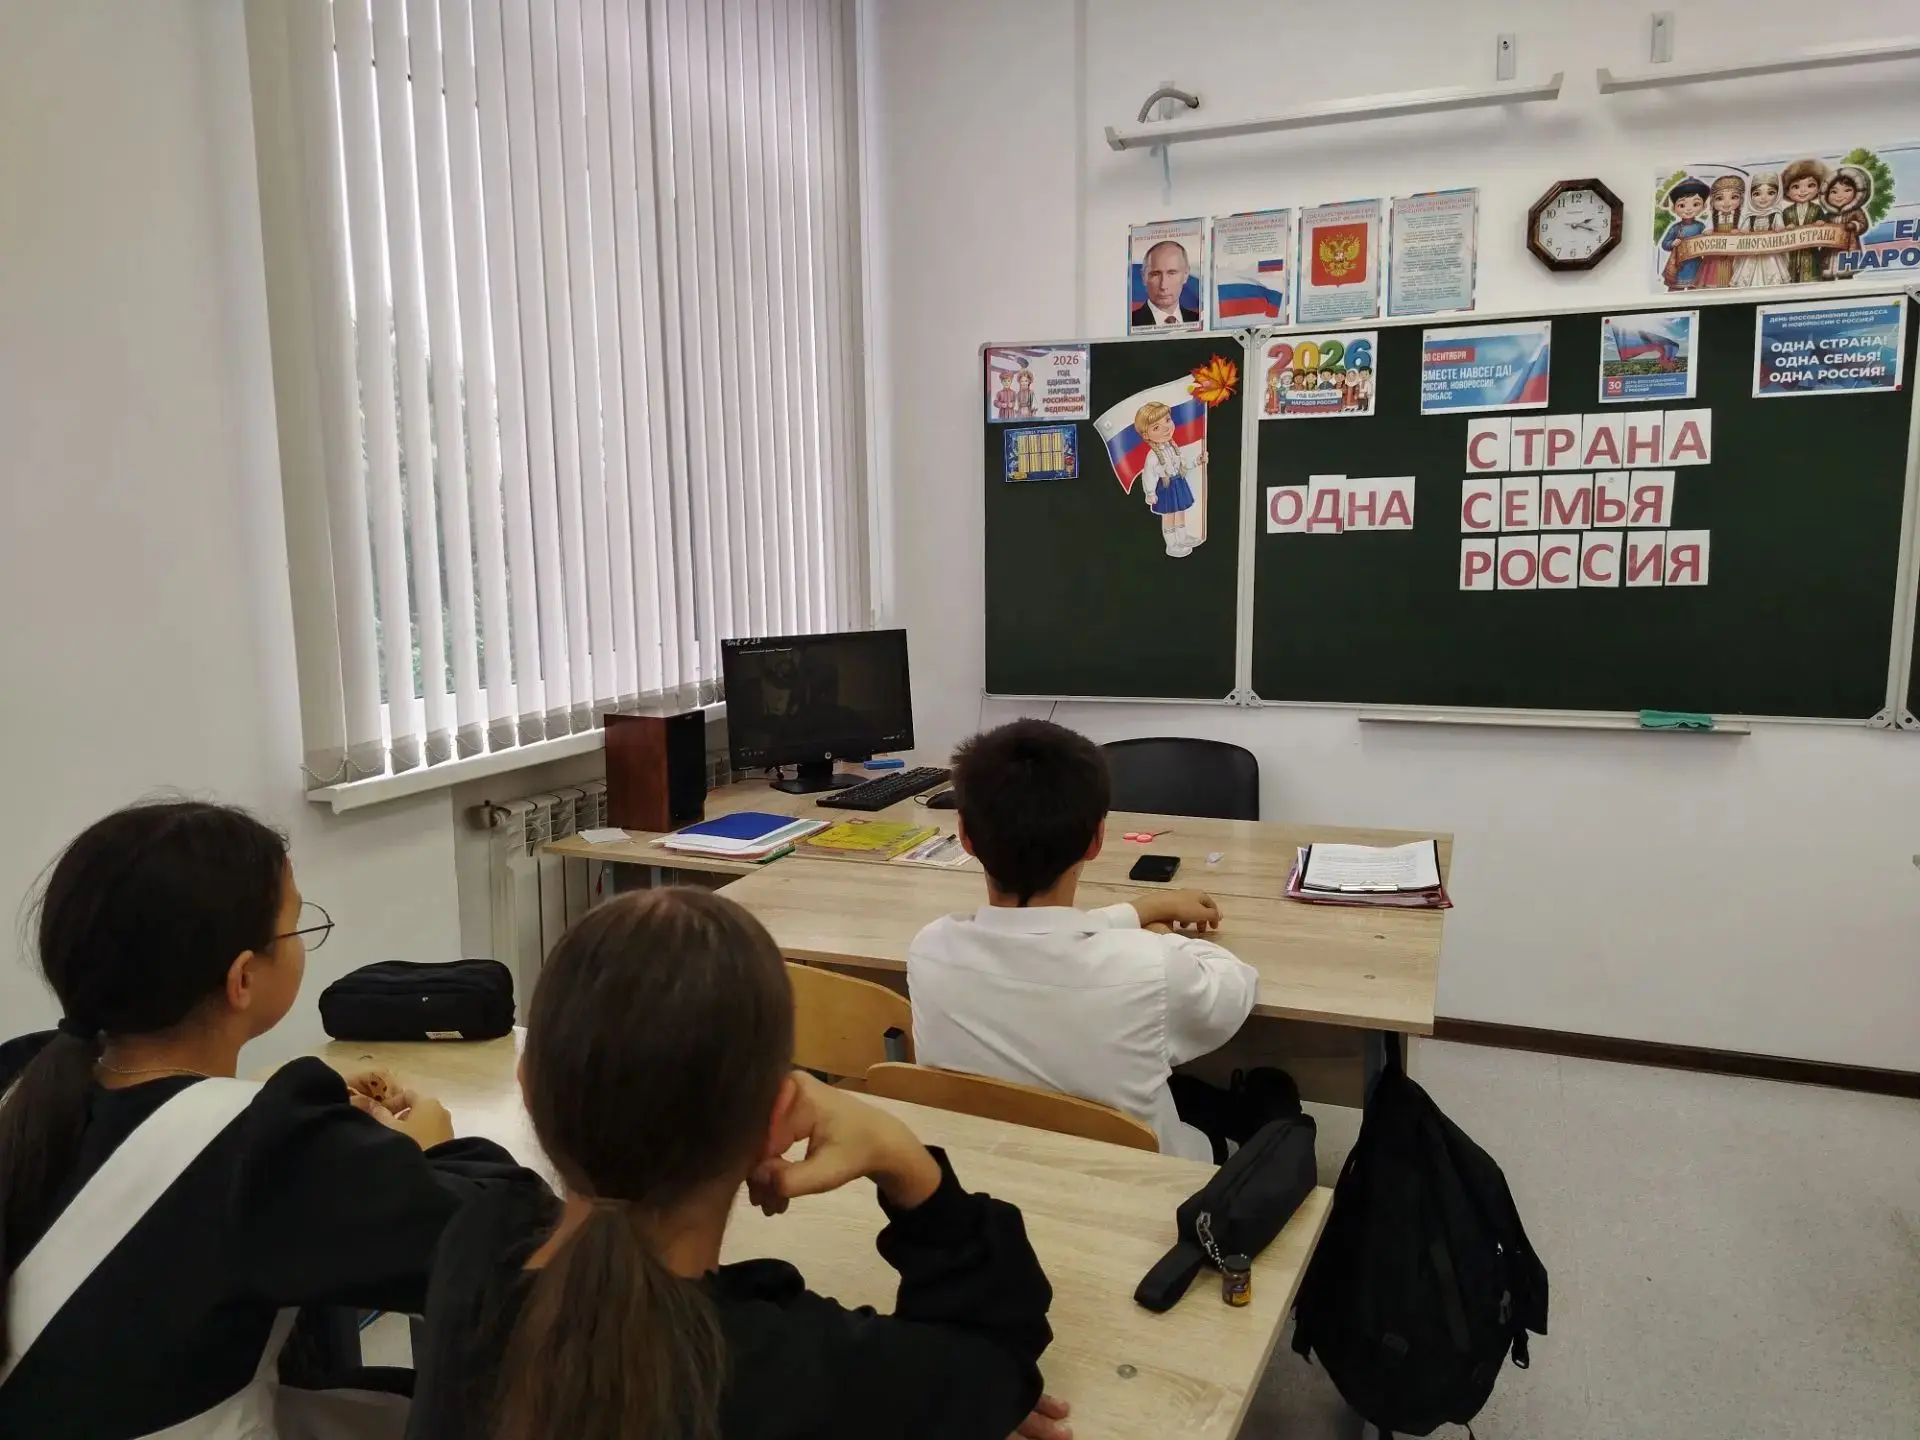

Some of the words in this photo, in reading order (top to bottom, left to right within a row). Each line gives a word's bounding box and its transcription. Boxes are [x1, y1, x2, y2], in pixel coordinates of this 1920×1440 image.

[1557, 198, 1566, 208] 11
[1571, 193, 1582, 204] 12
[1589, 195, 1593, 204] 1
[1546, 209, 1556, 219] 10
[1597, 204, 1604, 214] 2
[1541, 223, 1549, 232] 9
[1602, 218, 1609, 228] 3
[1546, 238, 1553, 247] 8
[1693, 238, 1728, 252] РОССИЯ
[1736, 233, 1796, 250] МНОГОЛИКАЯ
[1799, 229, 1837, 242] СТРАНА
[1555, 247, 1562, 257] 7
[1569, 248, 1576, 258] 6
[1585, 245, 1592, 255] 5
[1838, 247, 1920, 270] НАРО
[1850, 309, 1888, 317] ДОНБАССА
[1771, 341, 1816, 353] ОДНА
[1820, 335, 1888, 349] СТРАНА!
[1053, 355, 1079, 366] 2026
[1268, 338, 1372, 373] 2026
[1432, 350, 1467, 361] СЕНТЯБРЯ
[1775, 355, 1820, 368] ОДНА
[1823, 351, 1881, 364] СЕМЬЯ!
[1423, 368, 1458, 381] ВМЕСТЕ
[1460, 364, 1512, 380] НАВСЕГДА!
[1769, 371, 1814, 383] ОДНА
[1818, 366, 1886, 380] РОССИЯ!
[1608, 381, 1622, 390] 30
[1469, 421, 1708, 469] СТРАНА
[1270, 489, 1412, 533] ОДНА
[1463, 485, 1664, 529] СЕМЬЯ
[1464, 544, 1700, 587] РОССИЯ
